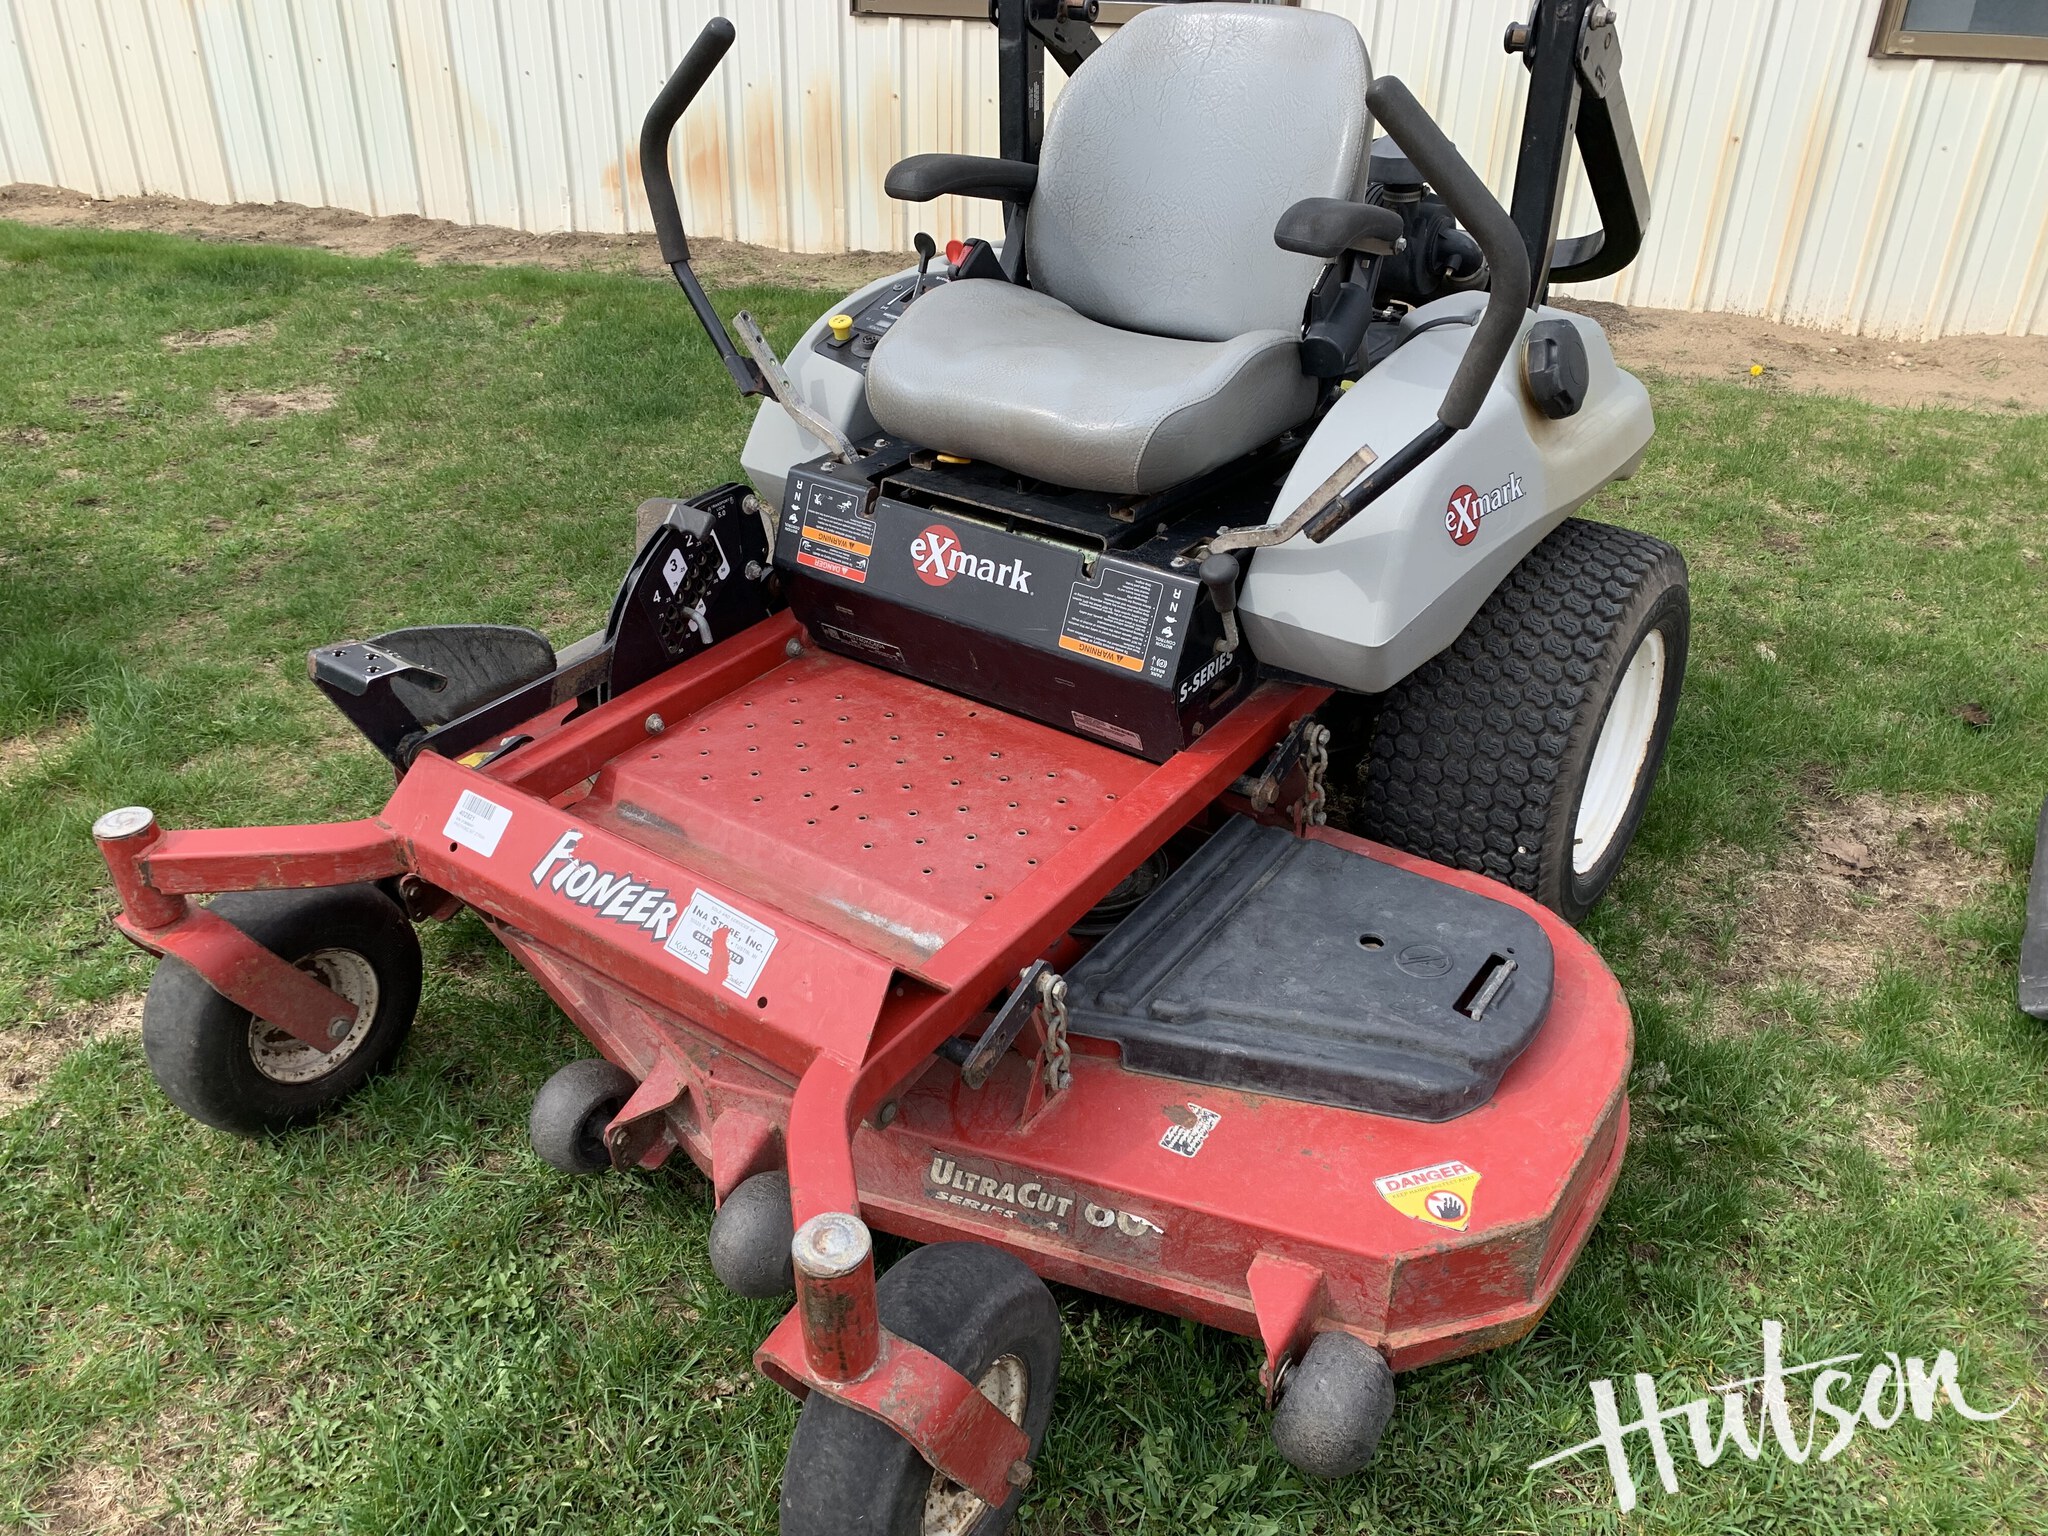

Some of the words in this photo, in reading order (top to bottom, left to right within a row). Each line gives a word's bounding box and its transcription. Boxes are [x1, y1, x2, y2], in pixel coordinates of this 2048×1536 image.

[796, 480, 803, 490] R
[794, 491, 801, 502] N
[818, 533, 848, 548] WARNING
[669, 558, 678, 572] 3
[814, 559, 841, 573] DANGER
[653, 589, 661, 603] 4
[1173, 588, 1182, 600] R
[1169, 602, 1178, 613] N
[1079, 643, 1114, 660] WARNING
[1179, 651, 1234, 703] S-SERIES
[1385, 1164, 1468, 1192] DANGER
